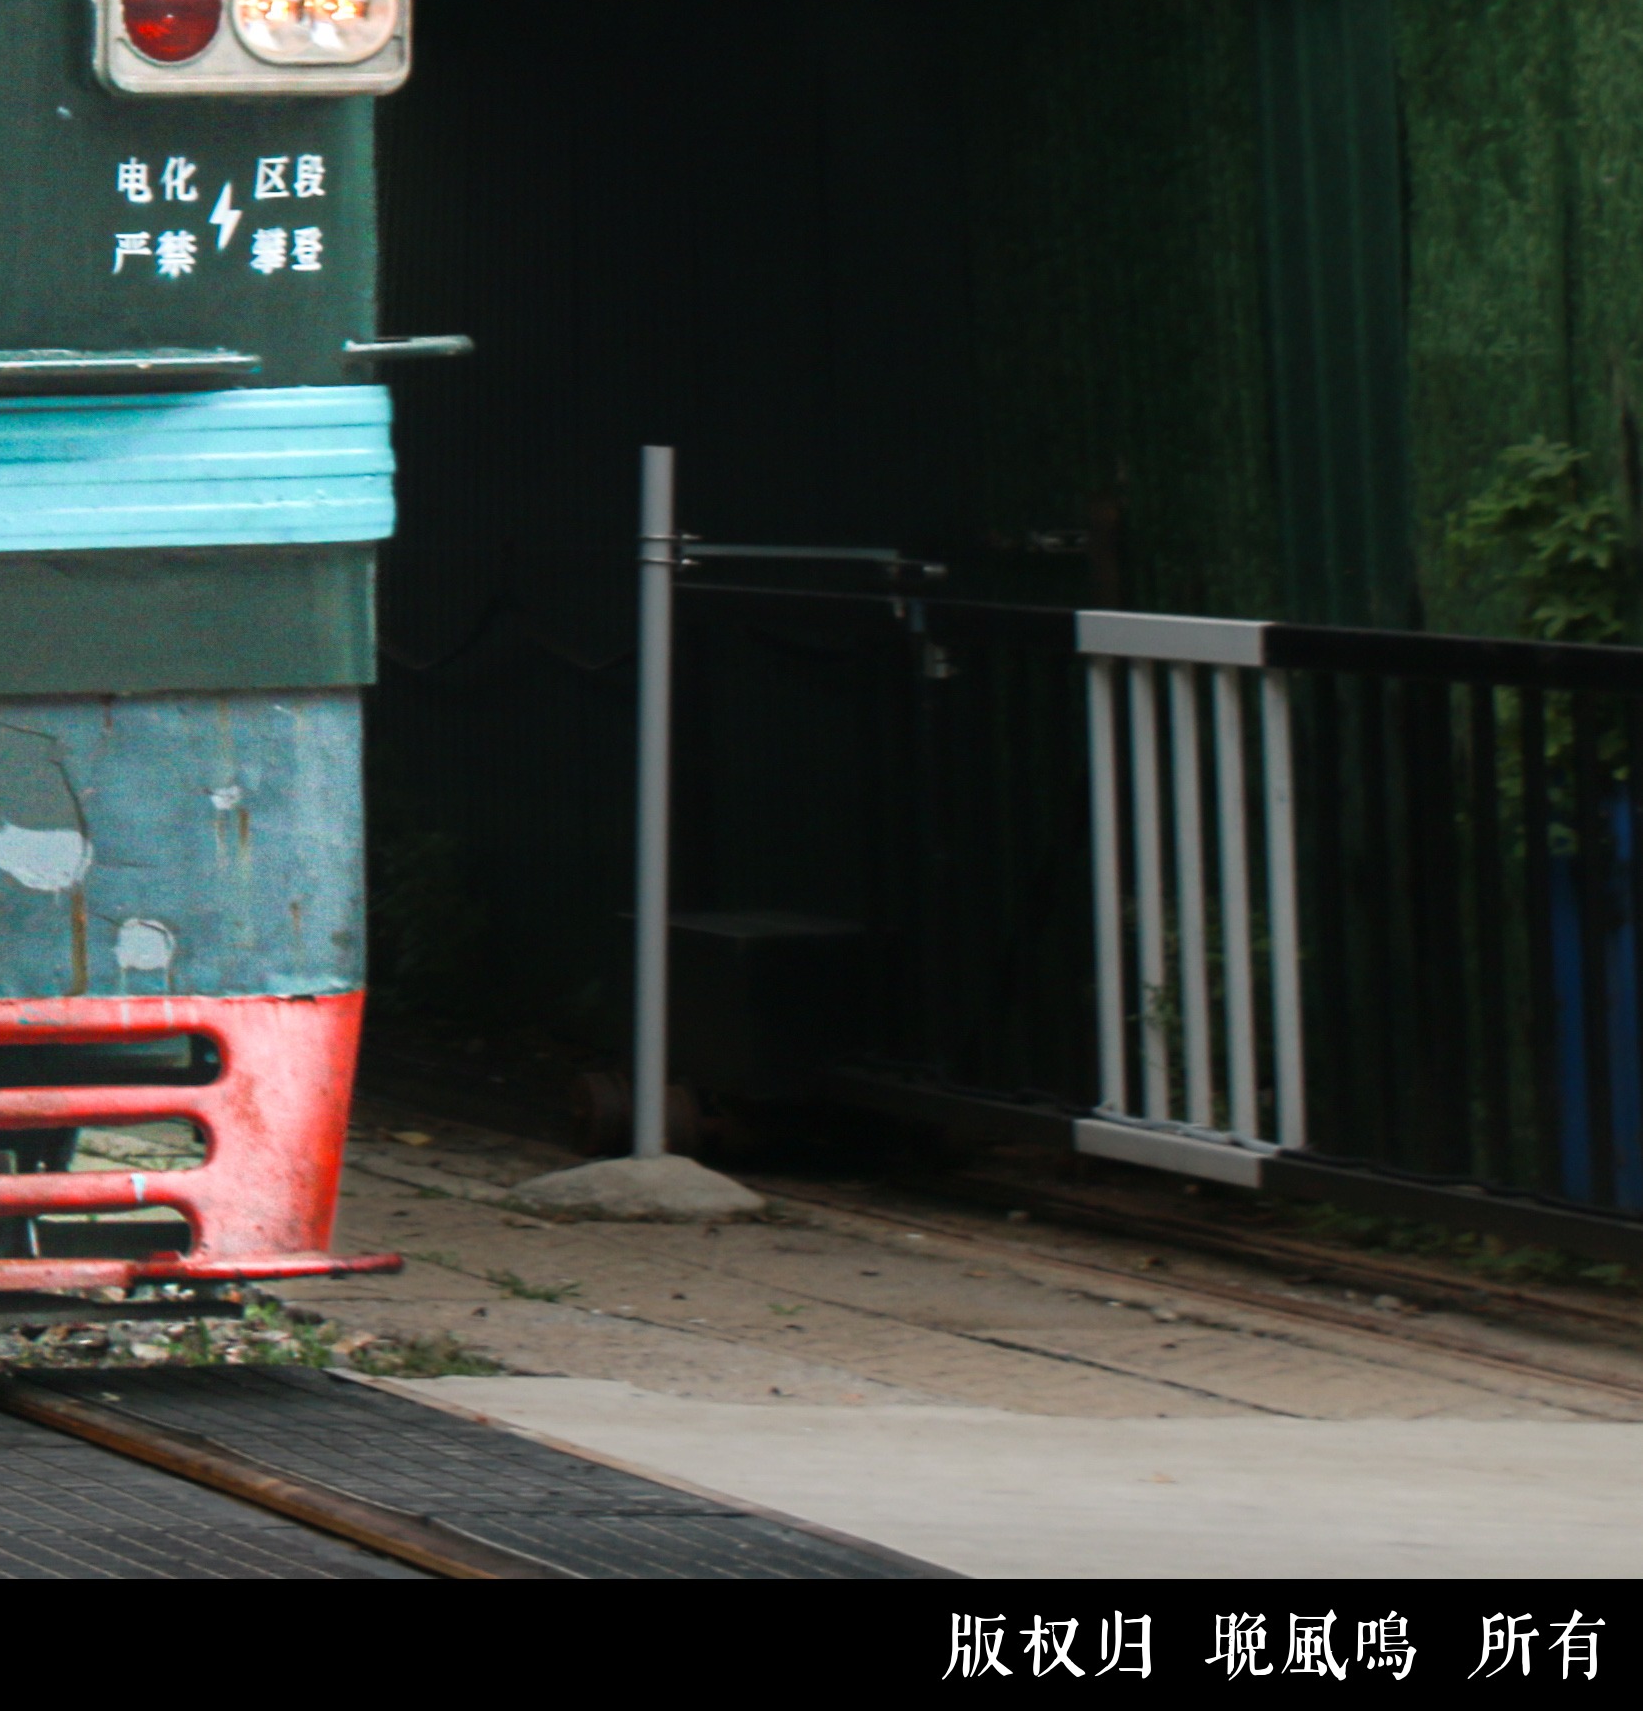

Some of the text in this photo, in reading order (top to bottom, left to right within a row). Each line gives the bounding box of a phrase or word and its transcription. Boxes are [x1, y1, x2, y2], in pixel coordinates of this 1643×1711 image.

[116, 154, 326, 203] 电化 区段
[113, 227, 324, 278] 严禁 攀登
